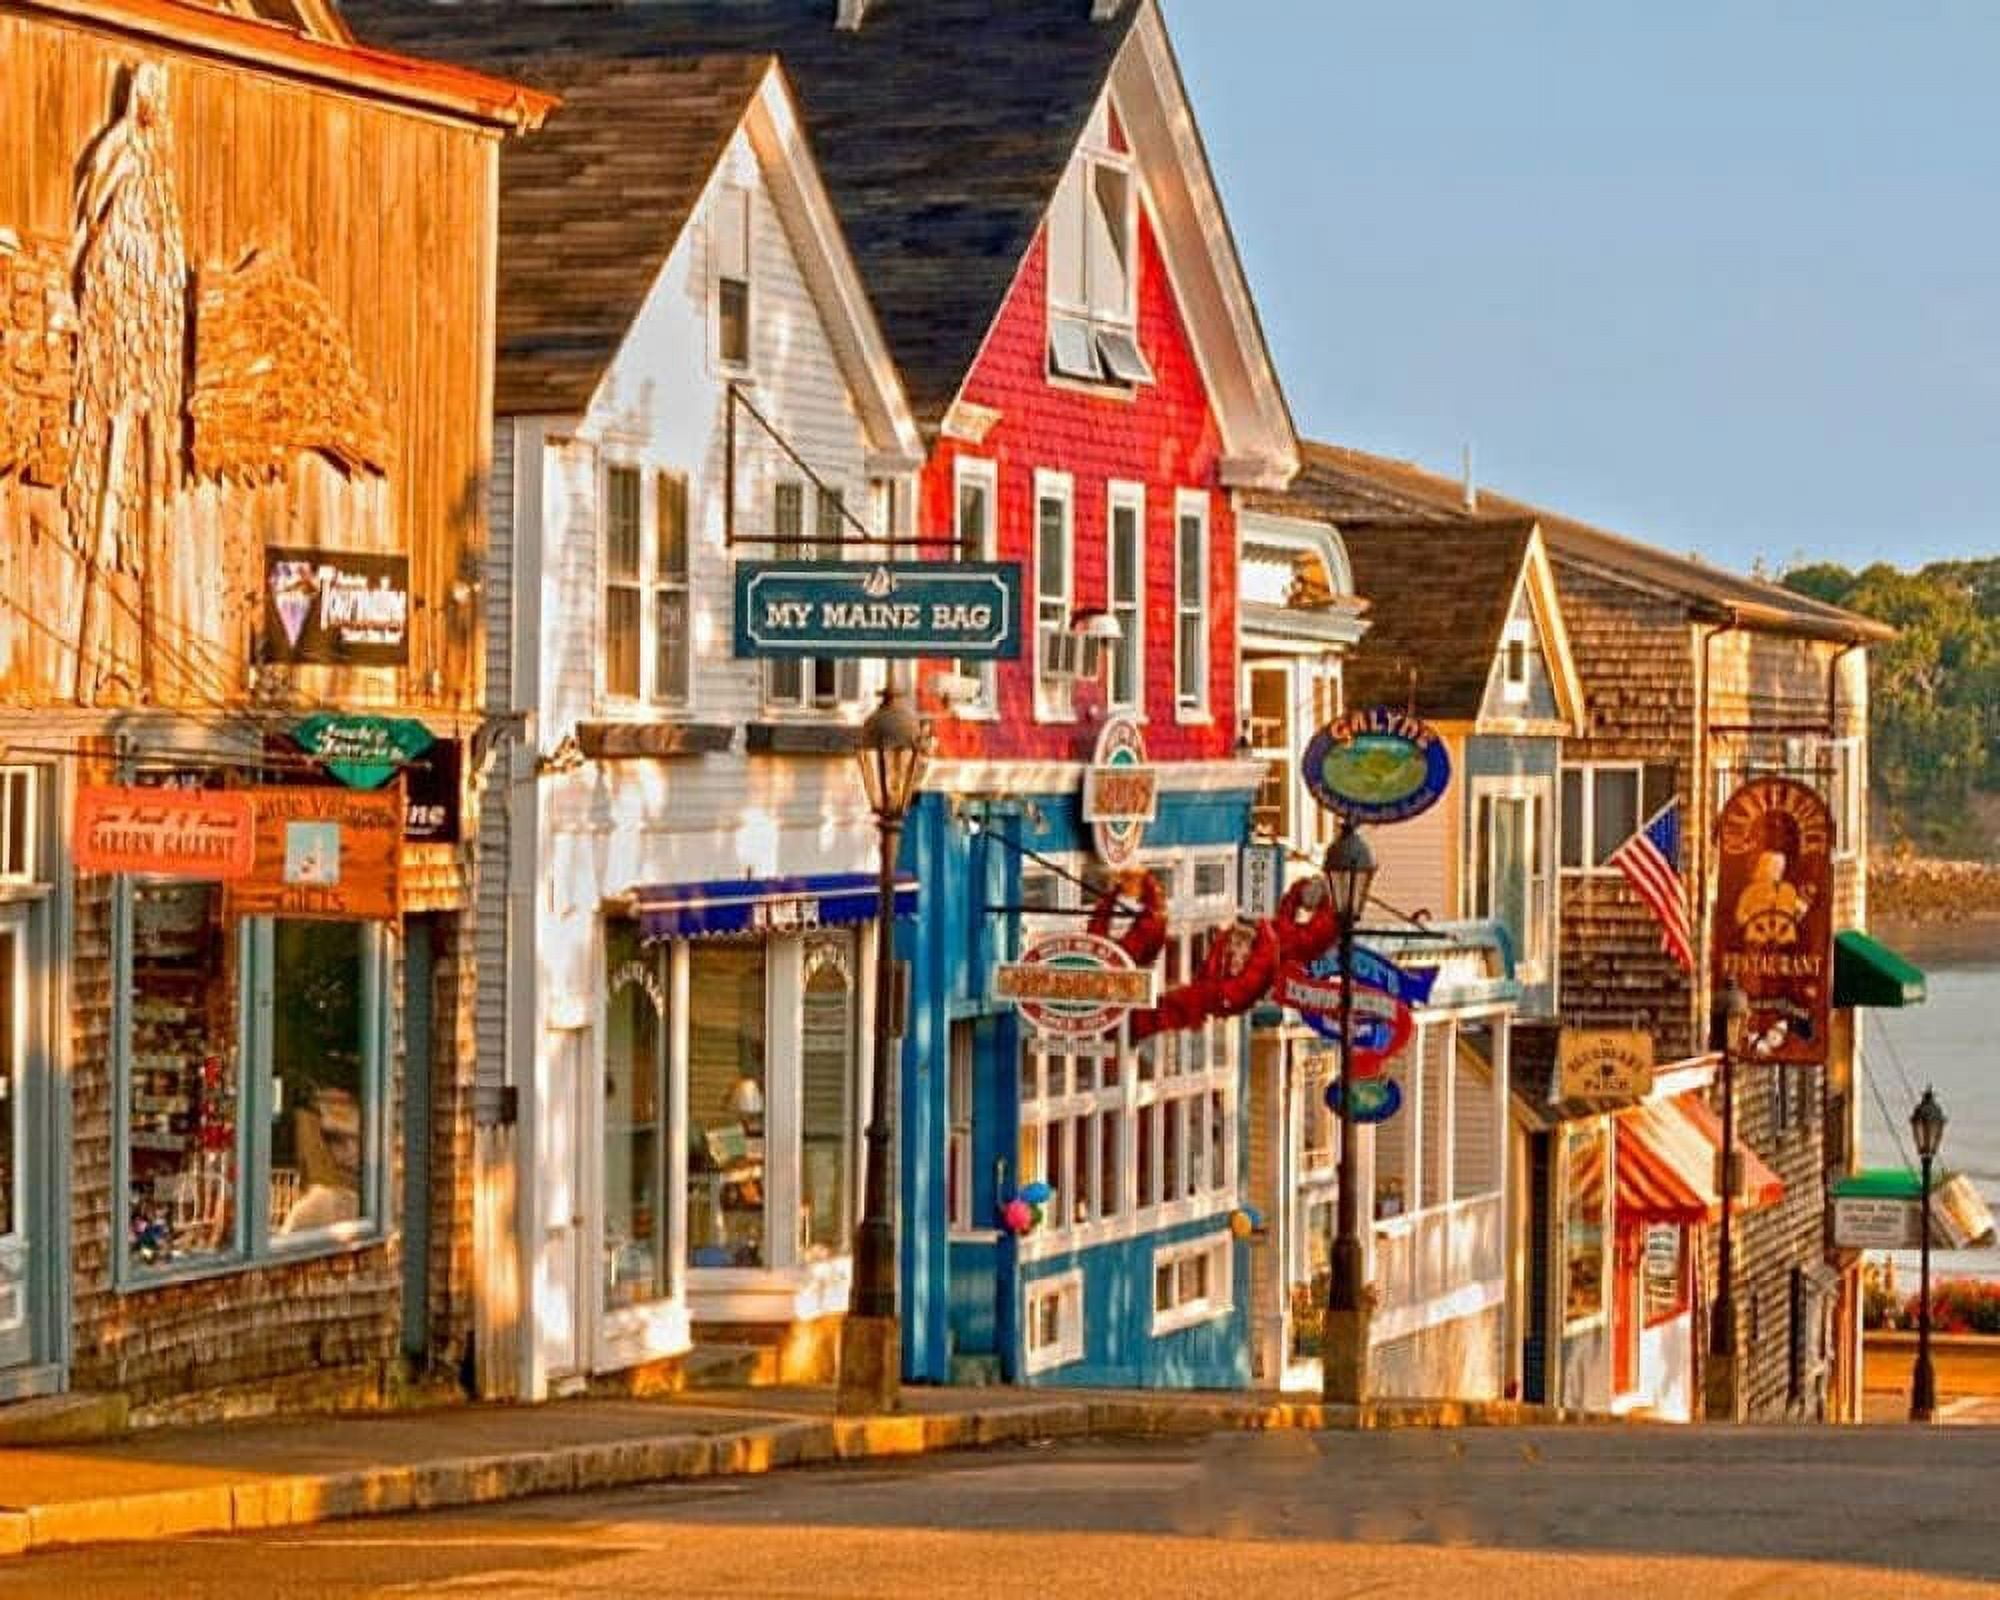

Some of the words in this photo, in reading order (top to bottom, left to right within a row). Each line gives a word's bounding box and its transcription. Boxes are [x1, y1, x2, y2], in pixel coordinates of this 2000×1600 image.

[766, 602, 813, 629] MY
[822, 603, 921, 630] MAINE
[931, 604, 992, 631] BAG
